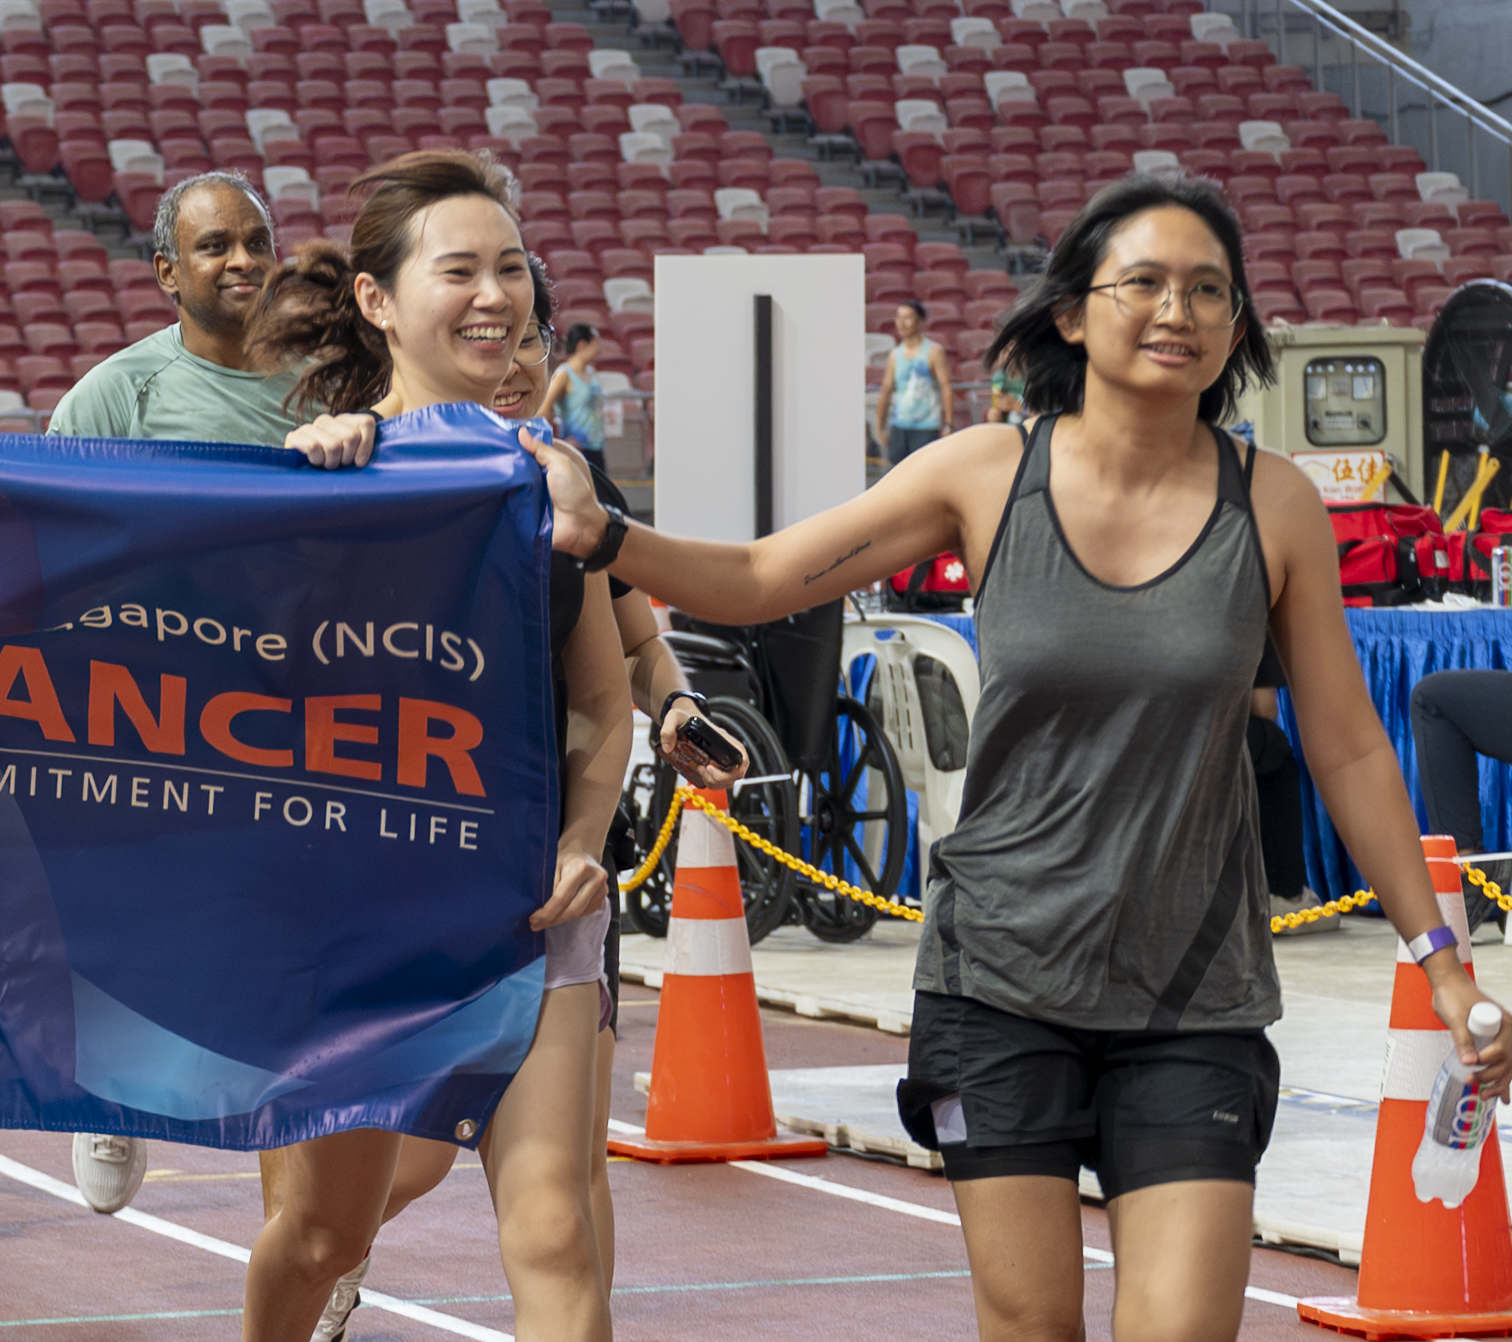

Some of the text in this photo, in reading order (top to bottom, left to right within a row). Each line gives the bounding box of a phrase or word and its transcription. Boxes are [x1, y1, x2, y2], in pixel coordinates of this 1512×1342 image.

[312, 620, 486, 682] (NCIS)
[253, 791, 347, 832] FOR
[379, 807, 479, 850] LIFE
